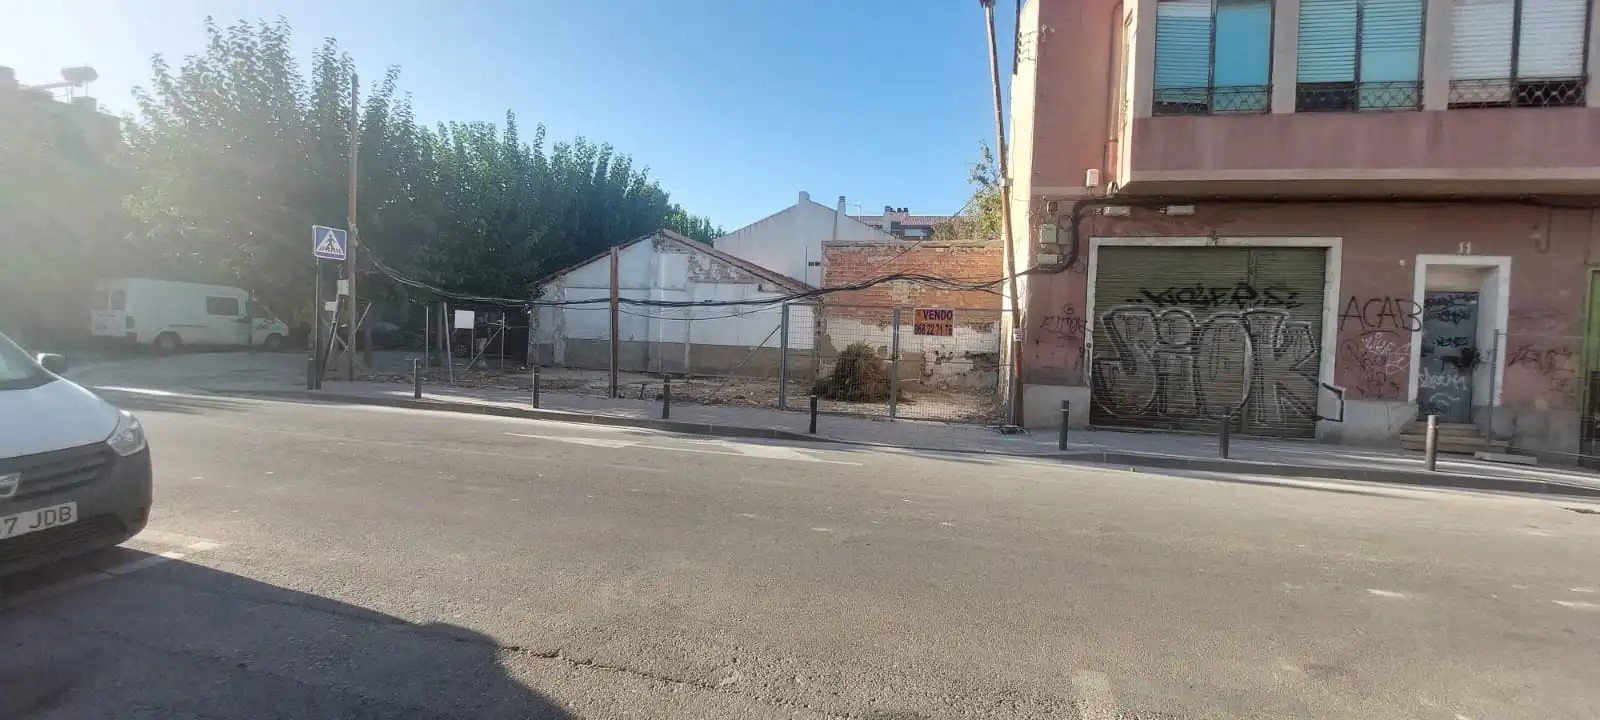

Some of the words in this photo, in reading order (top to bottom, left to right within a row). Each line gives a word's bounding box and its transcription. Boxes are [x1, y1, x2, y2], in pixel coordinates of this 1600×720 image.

[1458, 241, 1472, 254] 11
[923, 309, 953, 320] VENDO
[1339, 296, 1422, 332] ACAB
[927, 324, 935, 336] 22
[29, 506, 72, 529] JDB
